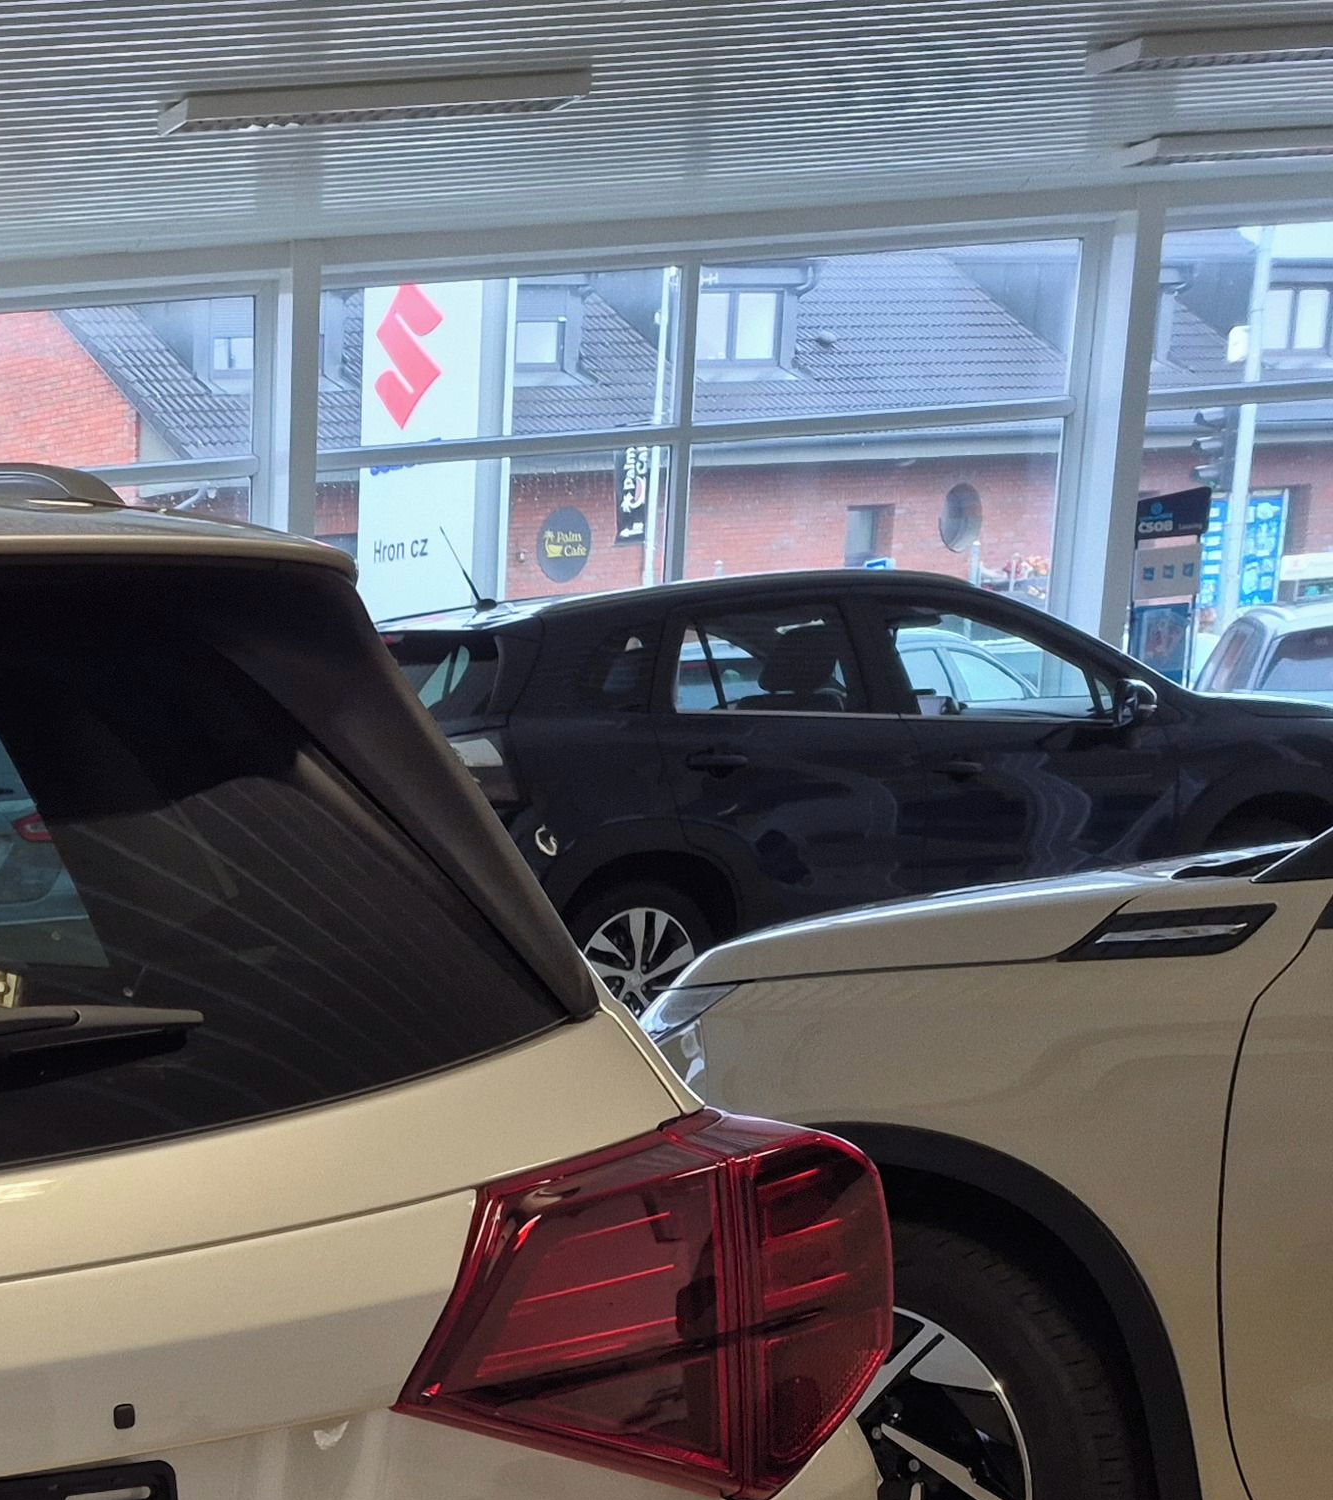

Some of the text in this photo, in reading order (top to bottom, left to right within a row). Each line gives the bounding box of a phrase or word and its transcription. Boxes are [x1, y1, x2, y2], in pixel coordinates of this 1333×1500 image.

[623, 447, 636, 490] Palm
[557, 529, 582, 543] Palm
[373, 539, 405, 564] Hron
[564, 544, 587, 557] Cafe
